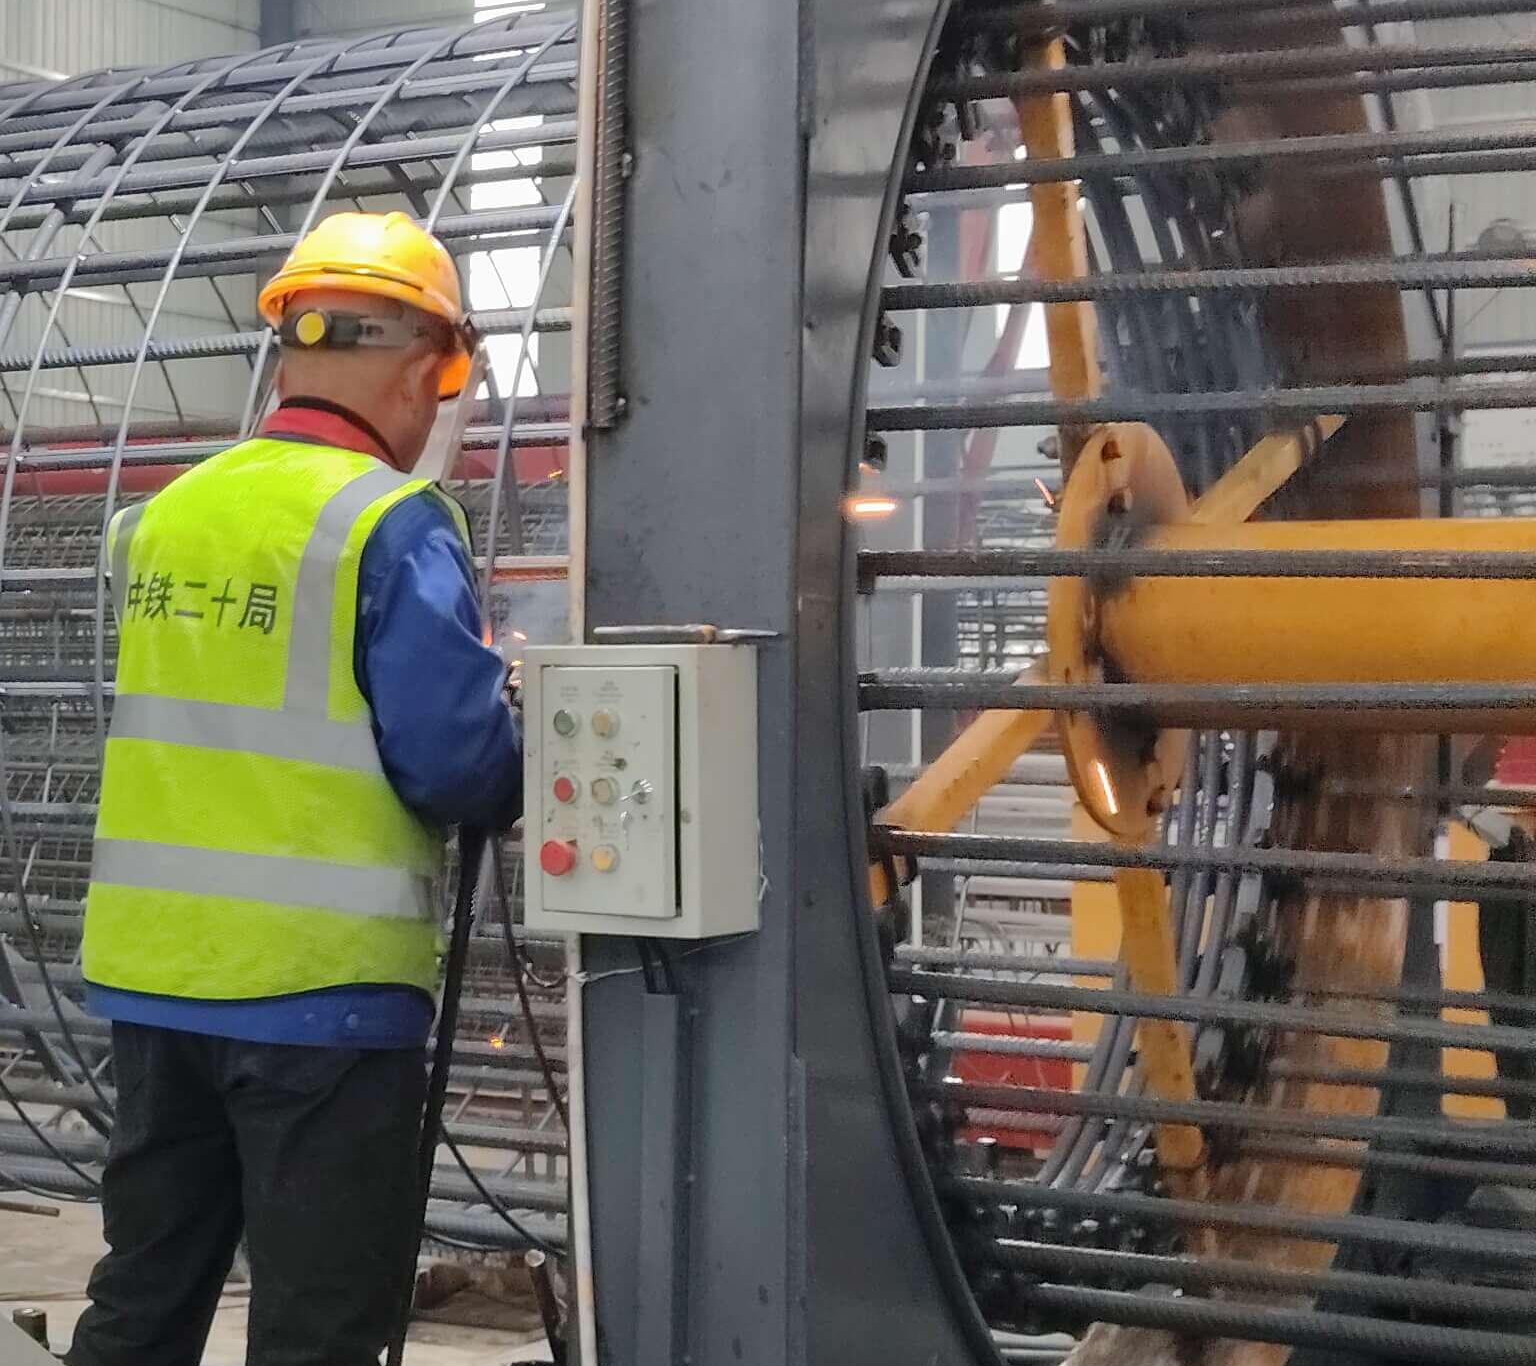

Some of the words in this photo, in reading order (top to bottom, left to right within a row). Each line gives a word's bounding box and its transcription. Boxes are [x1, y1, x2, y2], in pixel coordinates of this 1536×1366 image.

[127, 570, 279, 635] 中铁二十局
